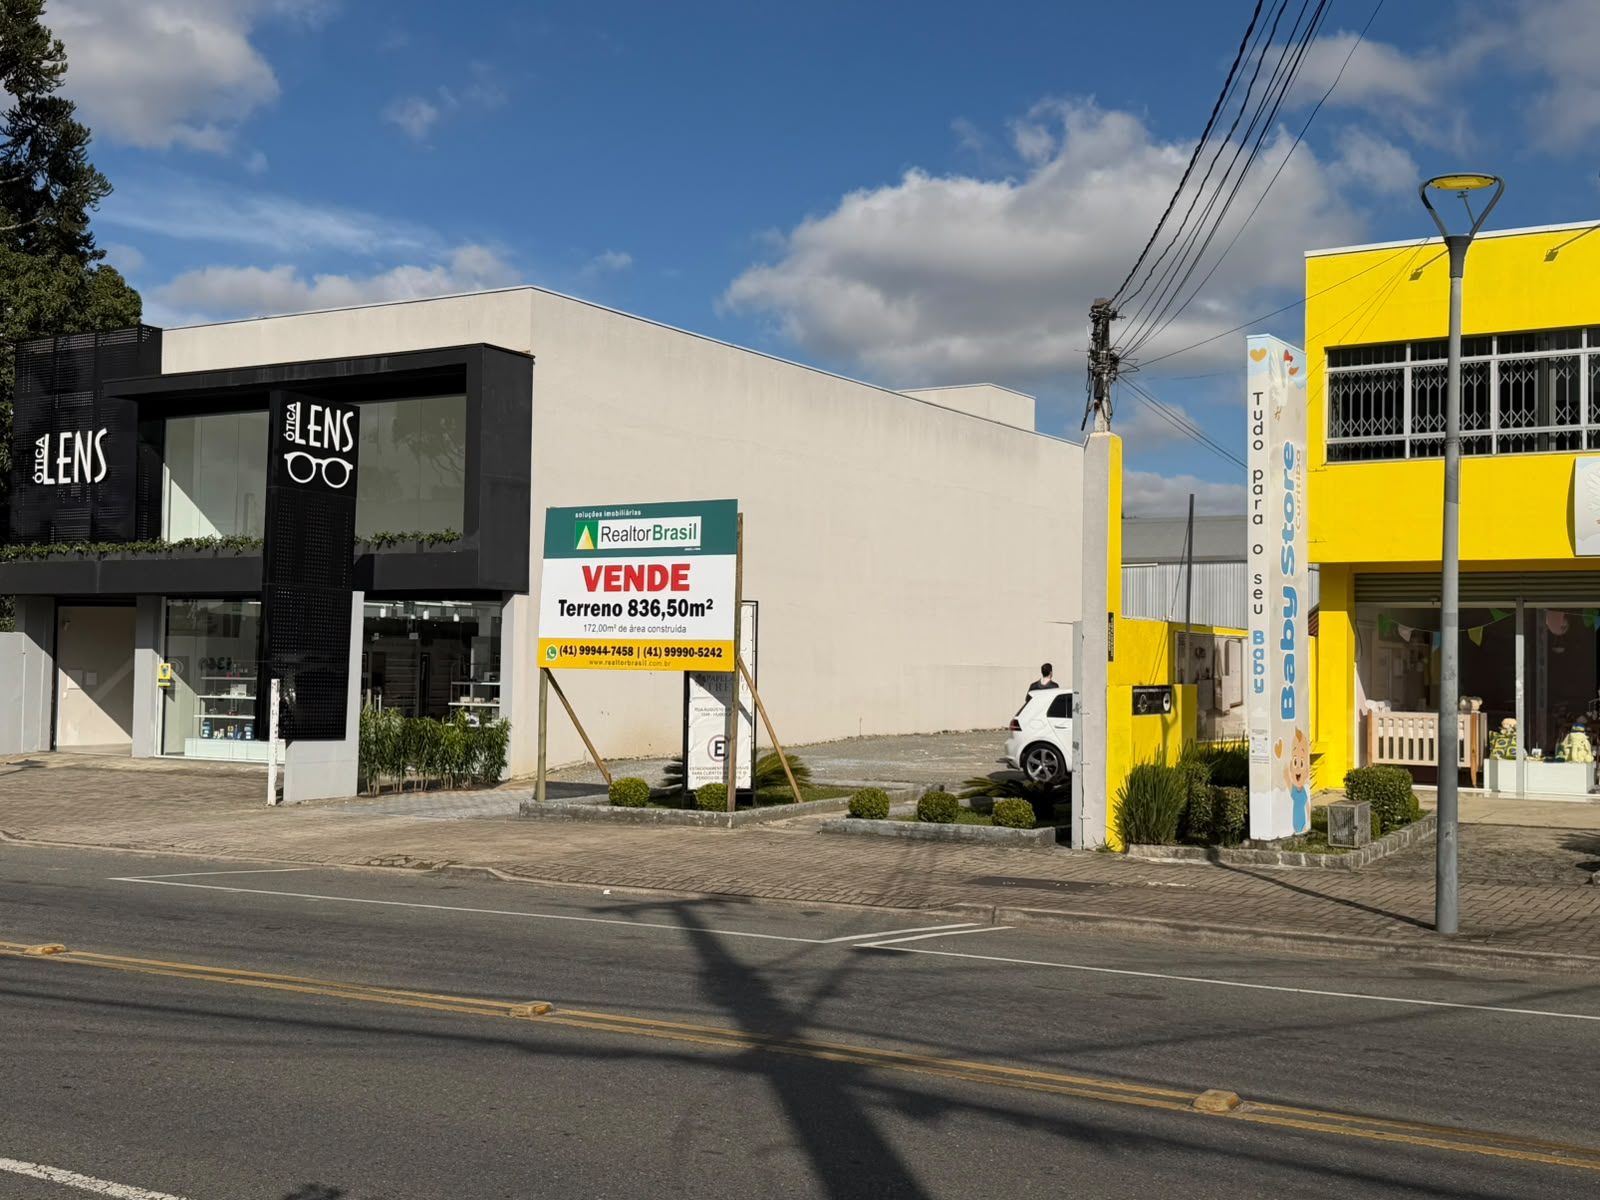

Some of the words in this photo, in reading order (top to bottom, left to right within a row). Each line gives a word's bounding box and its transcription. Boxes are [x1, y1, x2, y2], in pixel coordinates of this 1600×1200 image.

[283, 403, 296, 441] ÓTICA
[295, 401, 354, 452] LENS
[1252, 391, 1264, 451] Tudo
[32, 436, 46, 484] ÓTICA
[43, 428, 107, 485] LENS
[575, 510, 602, 518] soluções
[604, 509, 642, 517] imobiliárias
[1252, 469, 1264, 526] para
[1280, 440, 1296, 577] Store
[600, 523, 697, 543] RealtorBrasil
[1252, 543, 1264, 556] o
[581, 563, 691, 593] VENDE
[1252, 573, 1264, 615] seu
[558, 599, 623, 617] Terreno
[627, 598, 713, 621] 836,50m²
[629, 624, 645, 633] área
[559, 645, 577, 657] (41)
[579, 645, 634, 657] 99944-7458
[643, 646, 662, 659] (41)
[664, 647, 723, 658] 99990-5242
[1252, 630, 1265, 694] Baby
[1280, 584, 1298, 720] Baby
[714, 740, 726, 757] E
